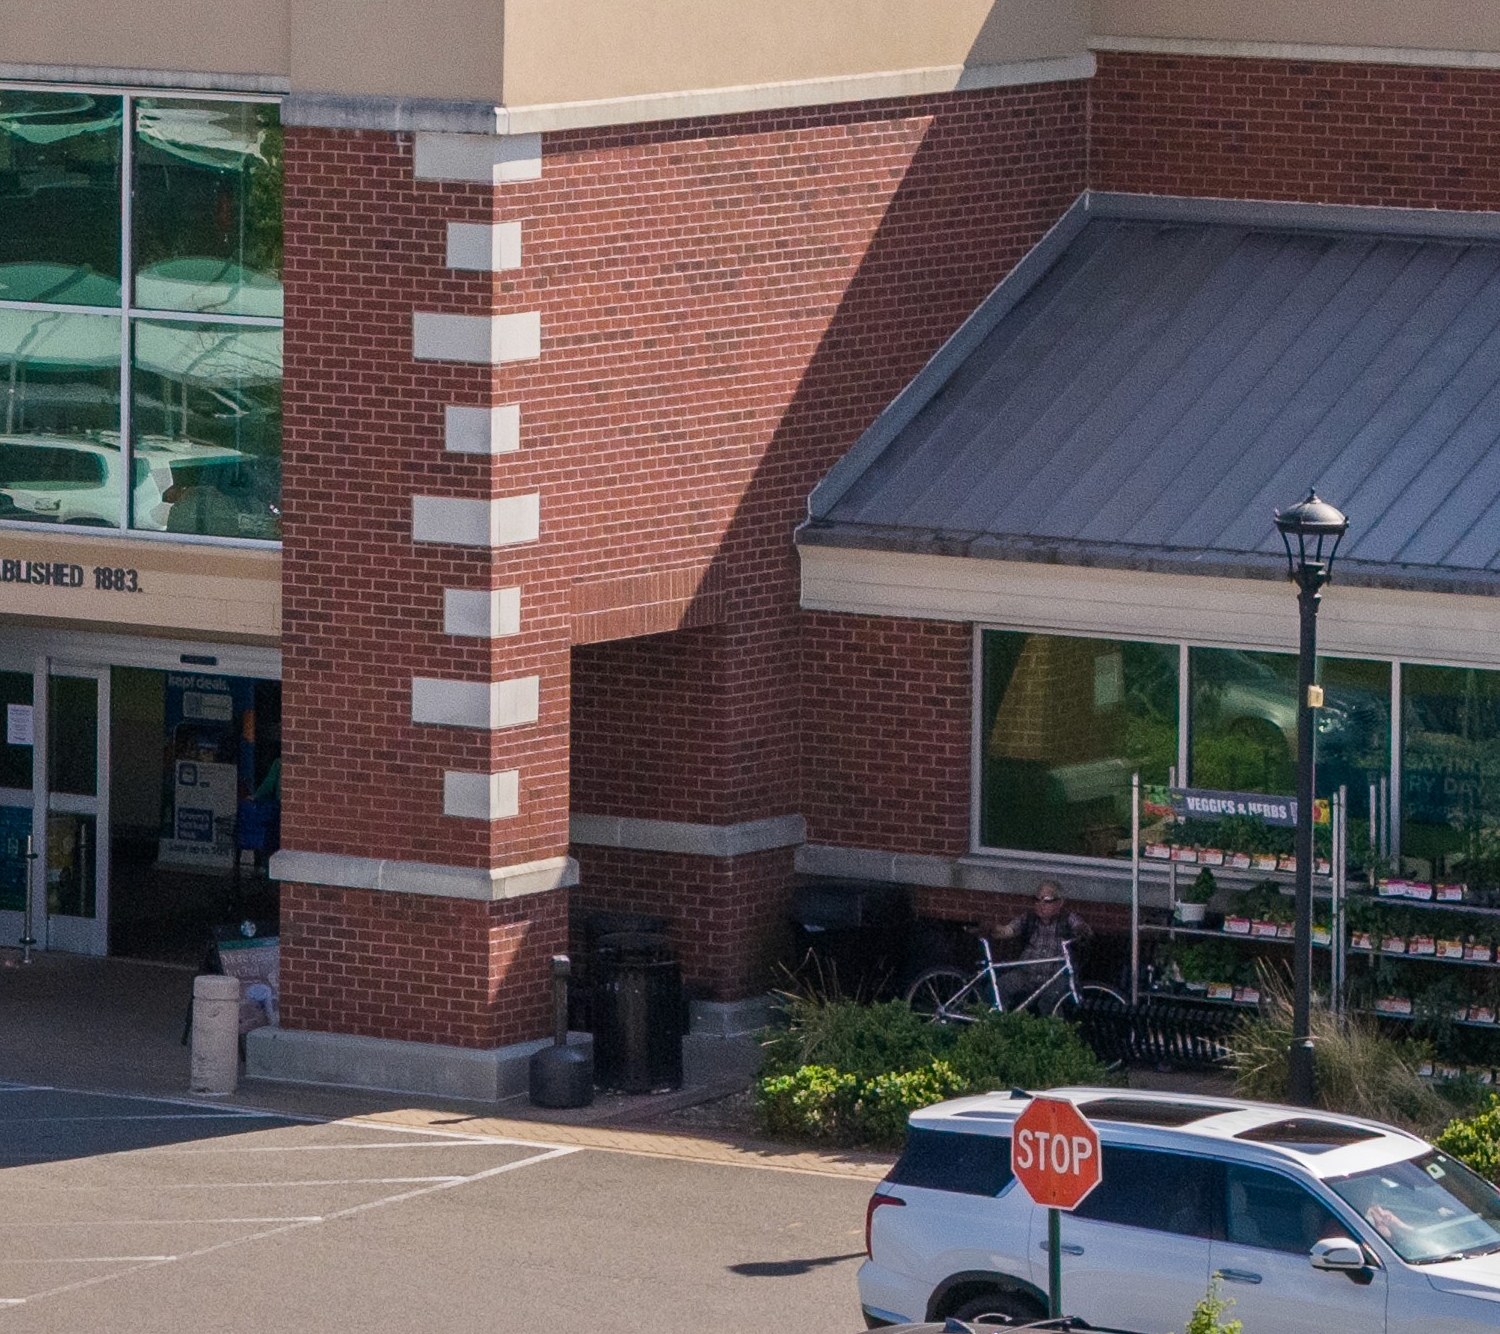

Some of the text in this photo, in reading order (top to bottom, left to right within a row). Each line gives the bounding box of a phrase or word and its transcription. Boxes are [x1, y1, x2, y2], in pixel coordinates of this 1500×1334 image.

[92, 567, 143, 593] 1883.
[1186, 796, 1287, 819] VEGGIES & HERBS
[1017, 1128, 1093, 1176] STOP
